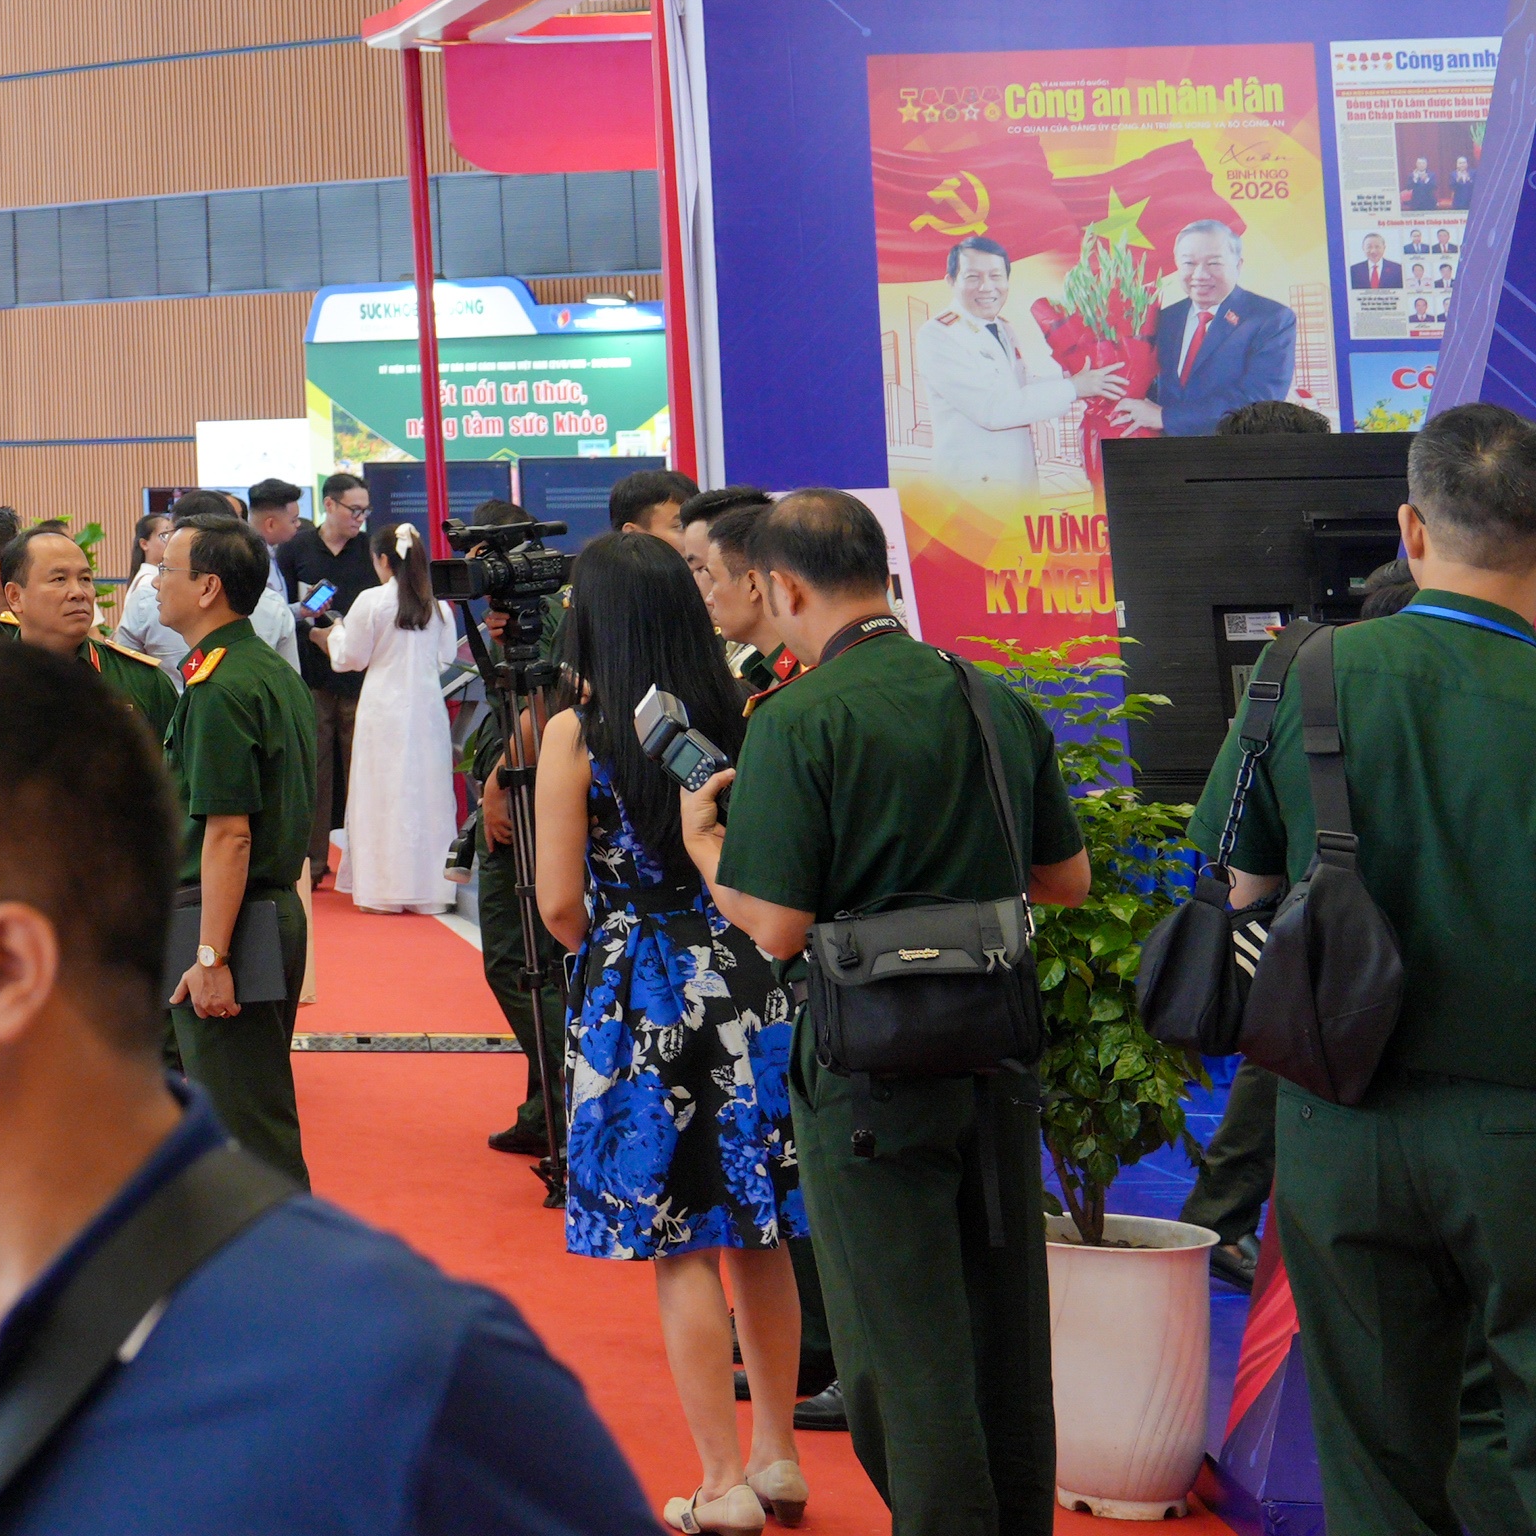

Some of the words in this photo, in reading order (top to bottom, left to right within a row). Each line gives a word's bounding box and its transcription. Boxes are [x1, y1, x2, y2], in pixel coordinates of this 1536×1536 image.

[1396, 51, 1444, 71] Công
[1448, 55, 1469, 67] an
[1473, 49, 1500, 67] nh
[1005, 81, 1085, 122] Công
[1092, 91, 1132, 114] an
[1137, 79, 1218, 115] nhân
[1224, 76, 1284, 113] dân
[1230, 181, 1289, 200] 2026
[1391, 365, 1437, 390] CÔ
[439, 379, 456, 406] ết
[406, 416, 457, 441] ng
[1023, 507, 1108, 556] VỮNG
[1043, 567, 1116, 614] NGU
[860, 618, 898, 633] Canon
